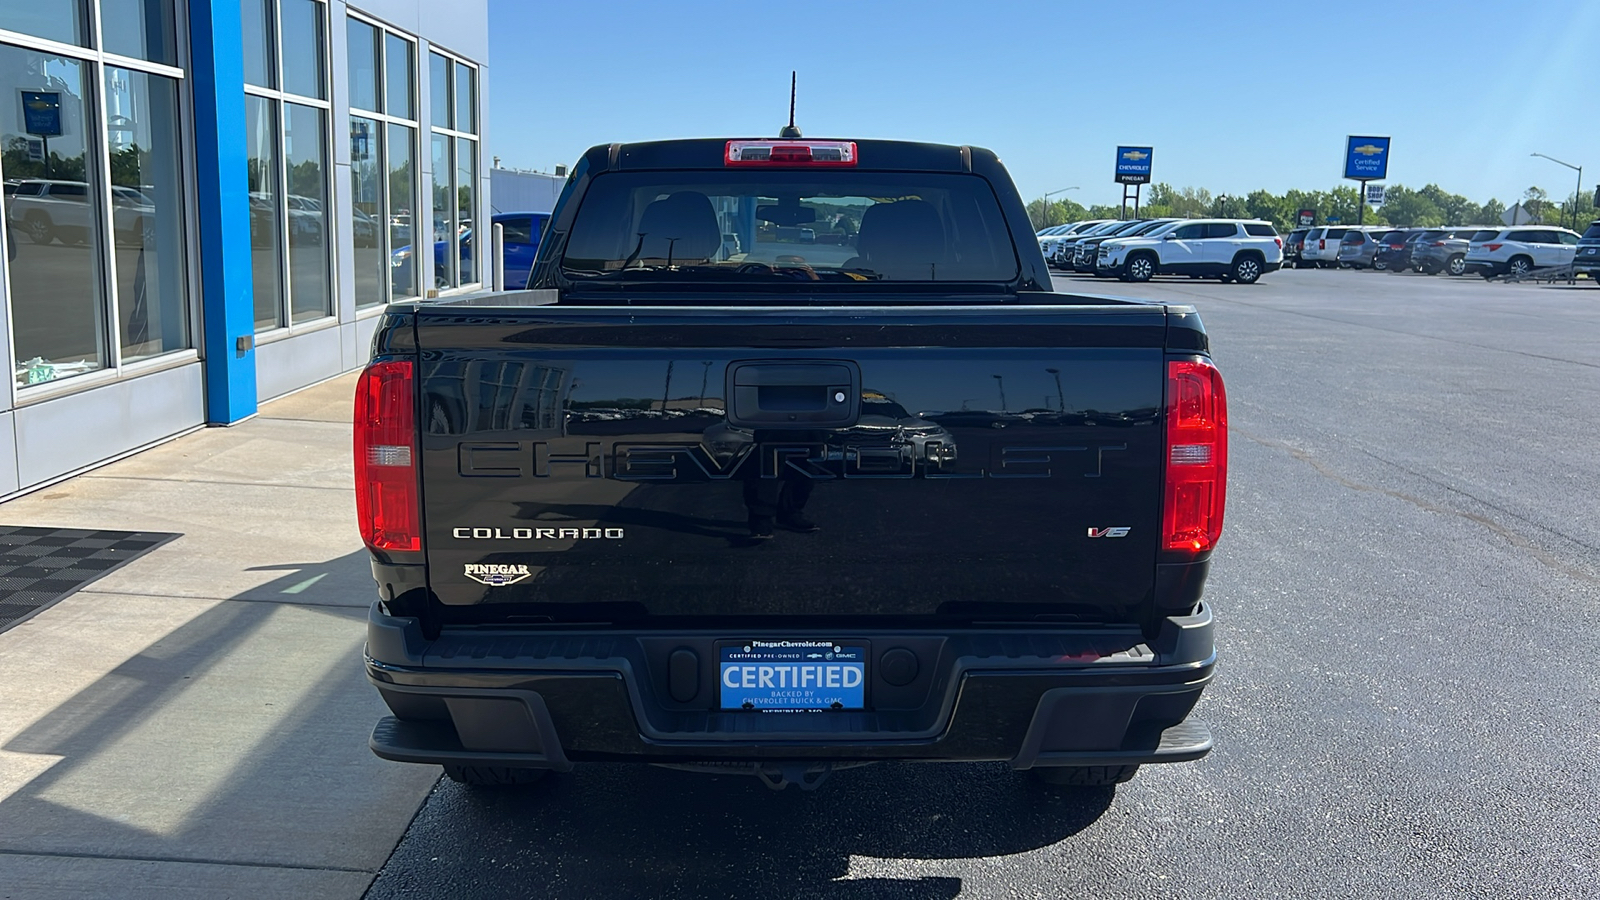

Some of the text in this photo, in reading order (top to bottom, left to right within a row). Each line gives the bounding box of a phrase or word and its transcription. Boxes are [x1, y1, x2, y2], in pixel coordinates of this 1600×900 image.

[457, 440, 1128, 479] CHEVROLET
[453, 527, 624, 539] COLORADO
[1087, 526, 1131, 538] V6
[464, 564, 530, 575] PINEGAR
[723, 666, 862, 688] CERTIFIED
